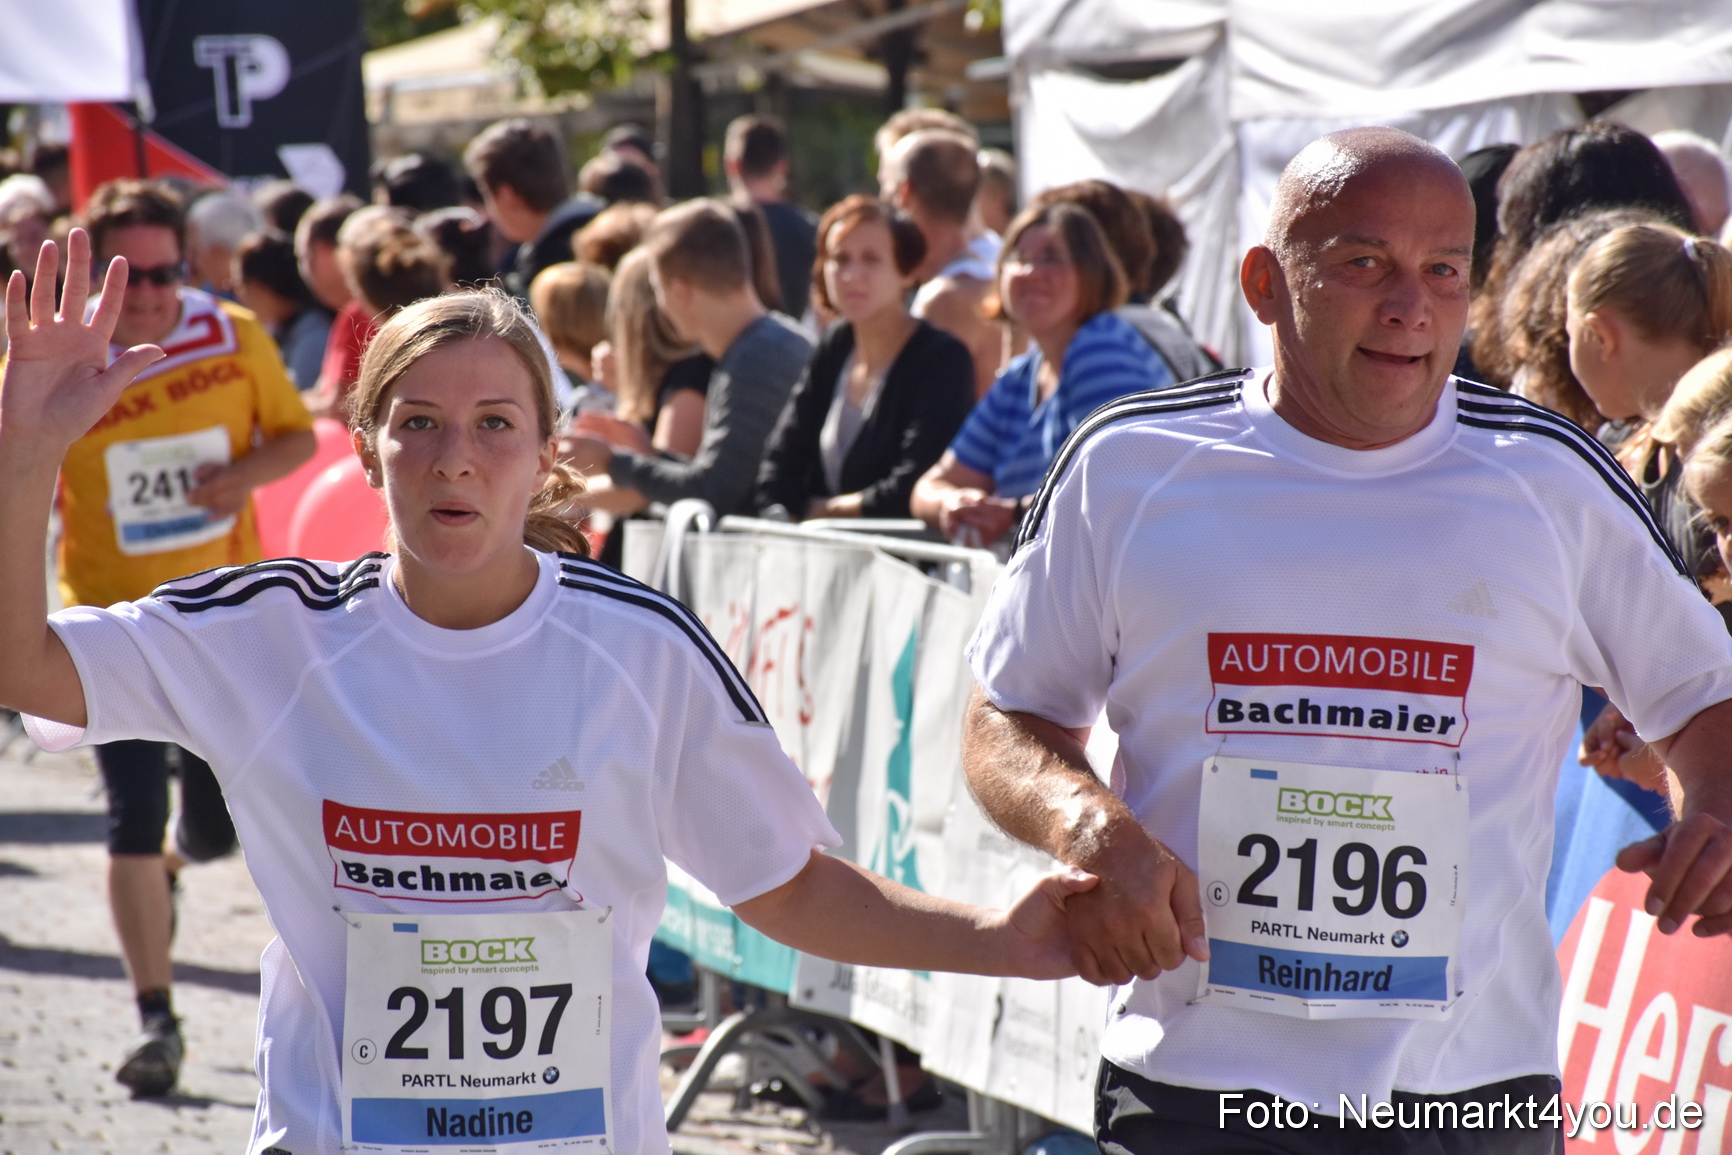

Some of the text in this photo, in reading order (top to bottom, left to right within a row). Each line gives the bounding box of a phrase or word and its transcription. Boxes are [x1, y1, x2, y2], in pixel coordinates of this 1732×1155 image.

[128, 467, 191, 505] 241
[1220, 643, 1459, 683] AUTOMOBILE
[1217, 698, 1456, 735] Bachmaier
[1277, 787, 1395, 822] BOCK
[334, 815, 567, 851] AUTOMOBILE
[1276, 813, 1396, 832] inspired by smart concepts
[1237, 833, 1428, 920] 2196
[1251, 920, 1386, 945] PARTL Neumarkt
[421, 937, 538, 965] BOCK
[421, 965, 539, 976] inspired by smart concepts
[1258, 955, 1393, 992] Reinhard
[384, 983, 573, 1060] 2197
[402, 1071, 537, 1088] PARTL Neumarkt
[427, 1106, 534, 1138] Nadine
